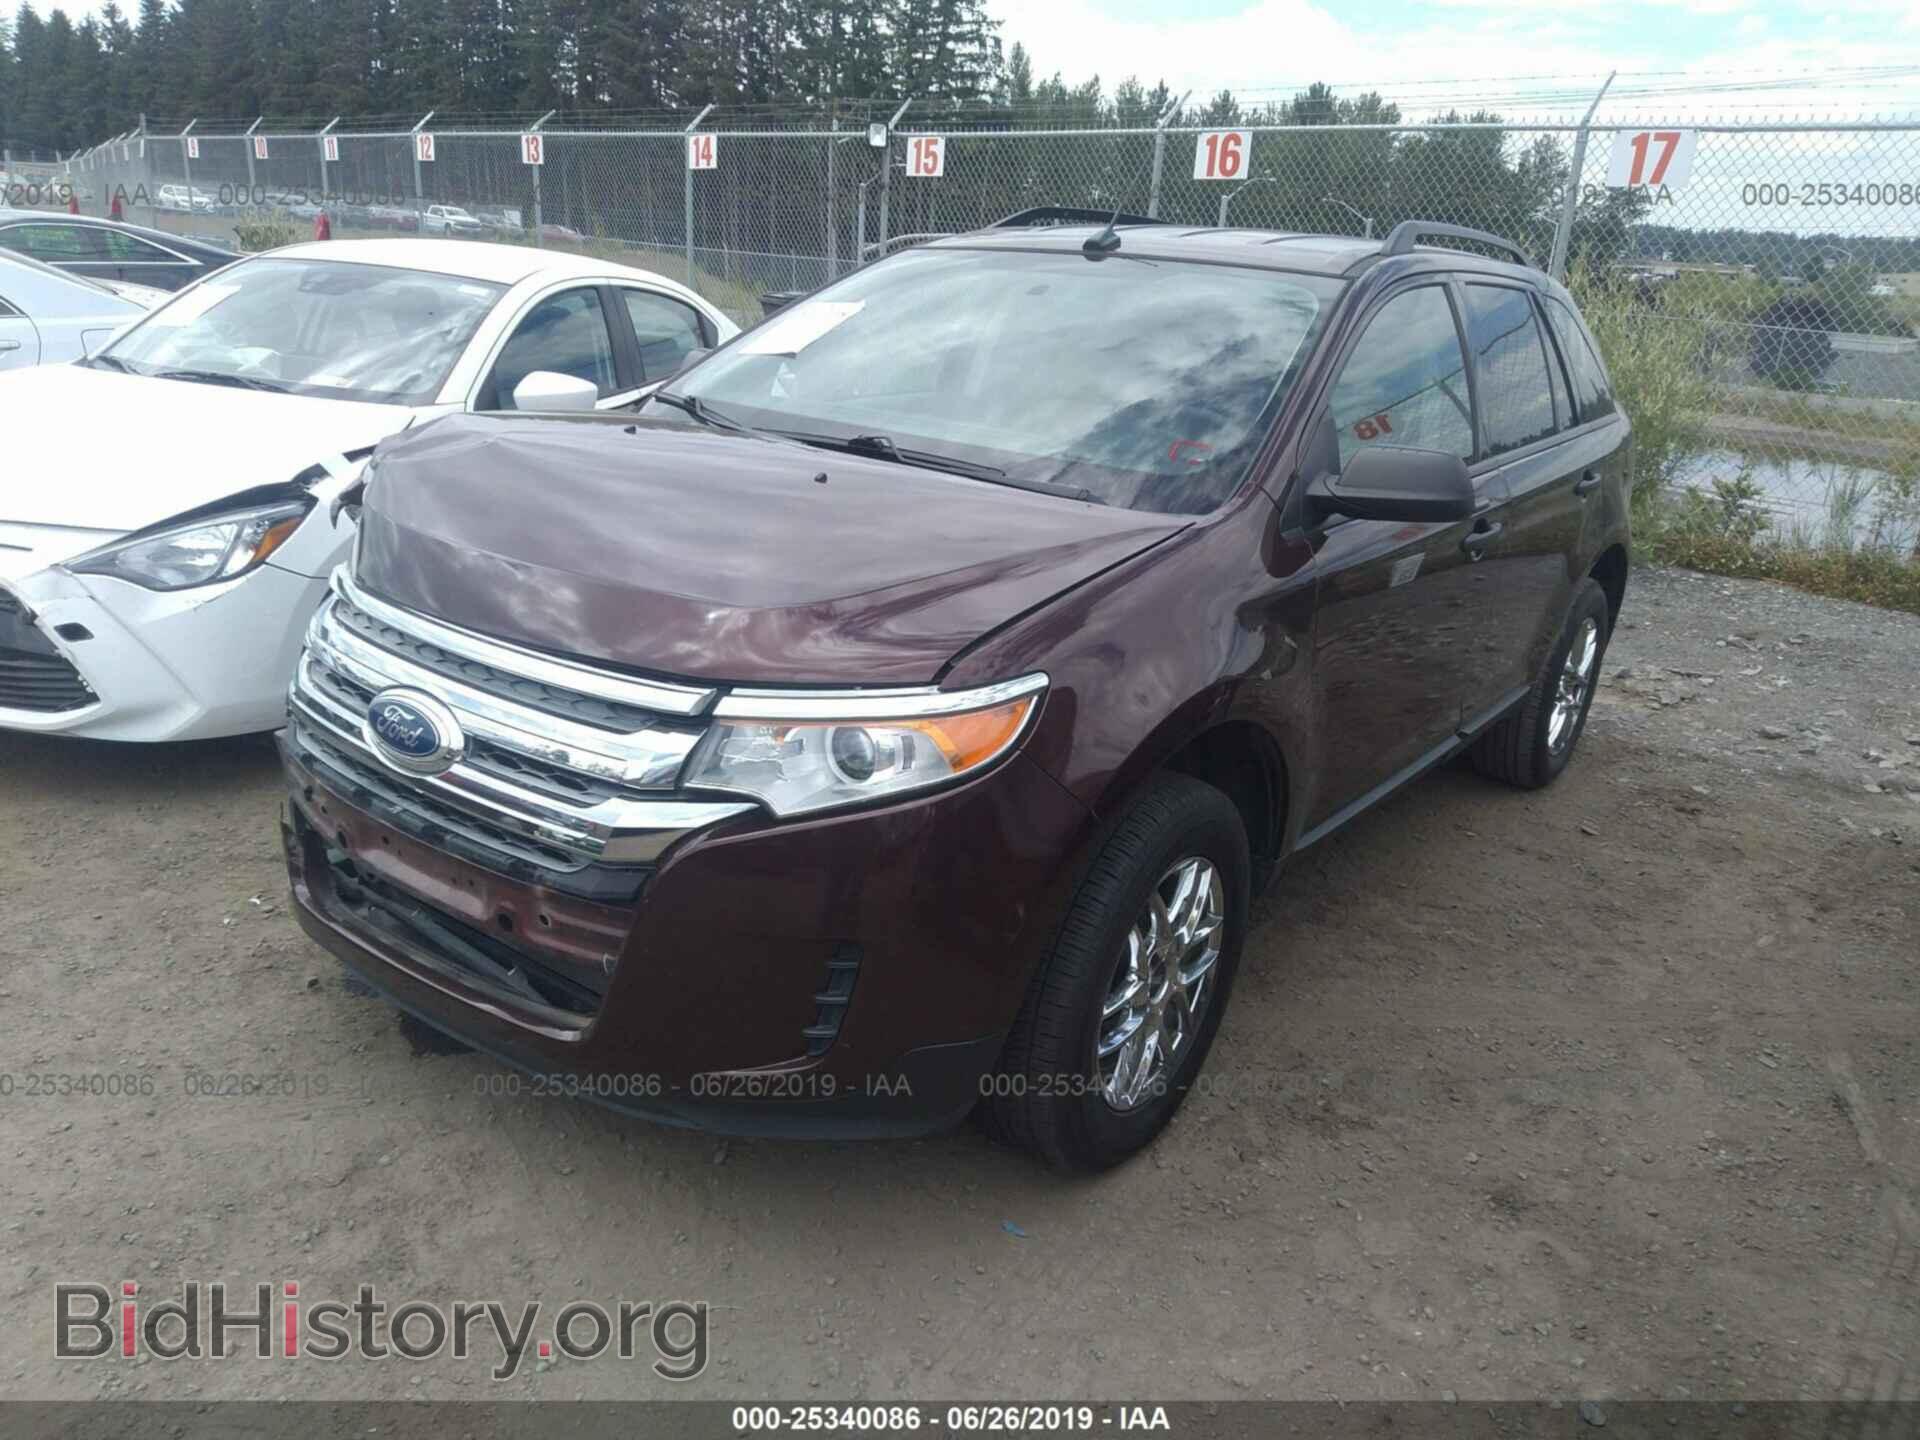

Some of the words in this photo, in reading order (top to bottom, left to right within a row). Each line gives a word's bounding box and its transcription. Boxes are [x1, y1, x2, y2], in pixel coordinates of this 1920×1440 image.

[326, 137, 336, 160] 11
[418, 136, 432, 160] 12
[525, 136, 540, 163] 13
[693, 136, 713, 167] 14
[913, 138, 939, 175] 15
[1205, 133, 1241, 177] 16
[1630, 132, 1681, 185] 17
[376, 705, 424, 747] Ford
